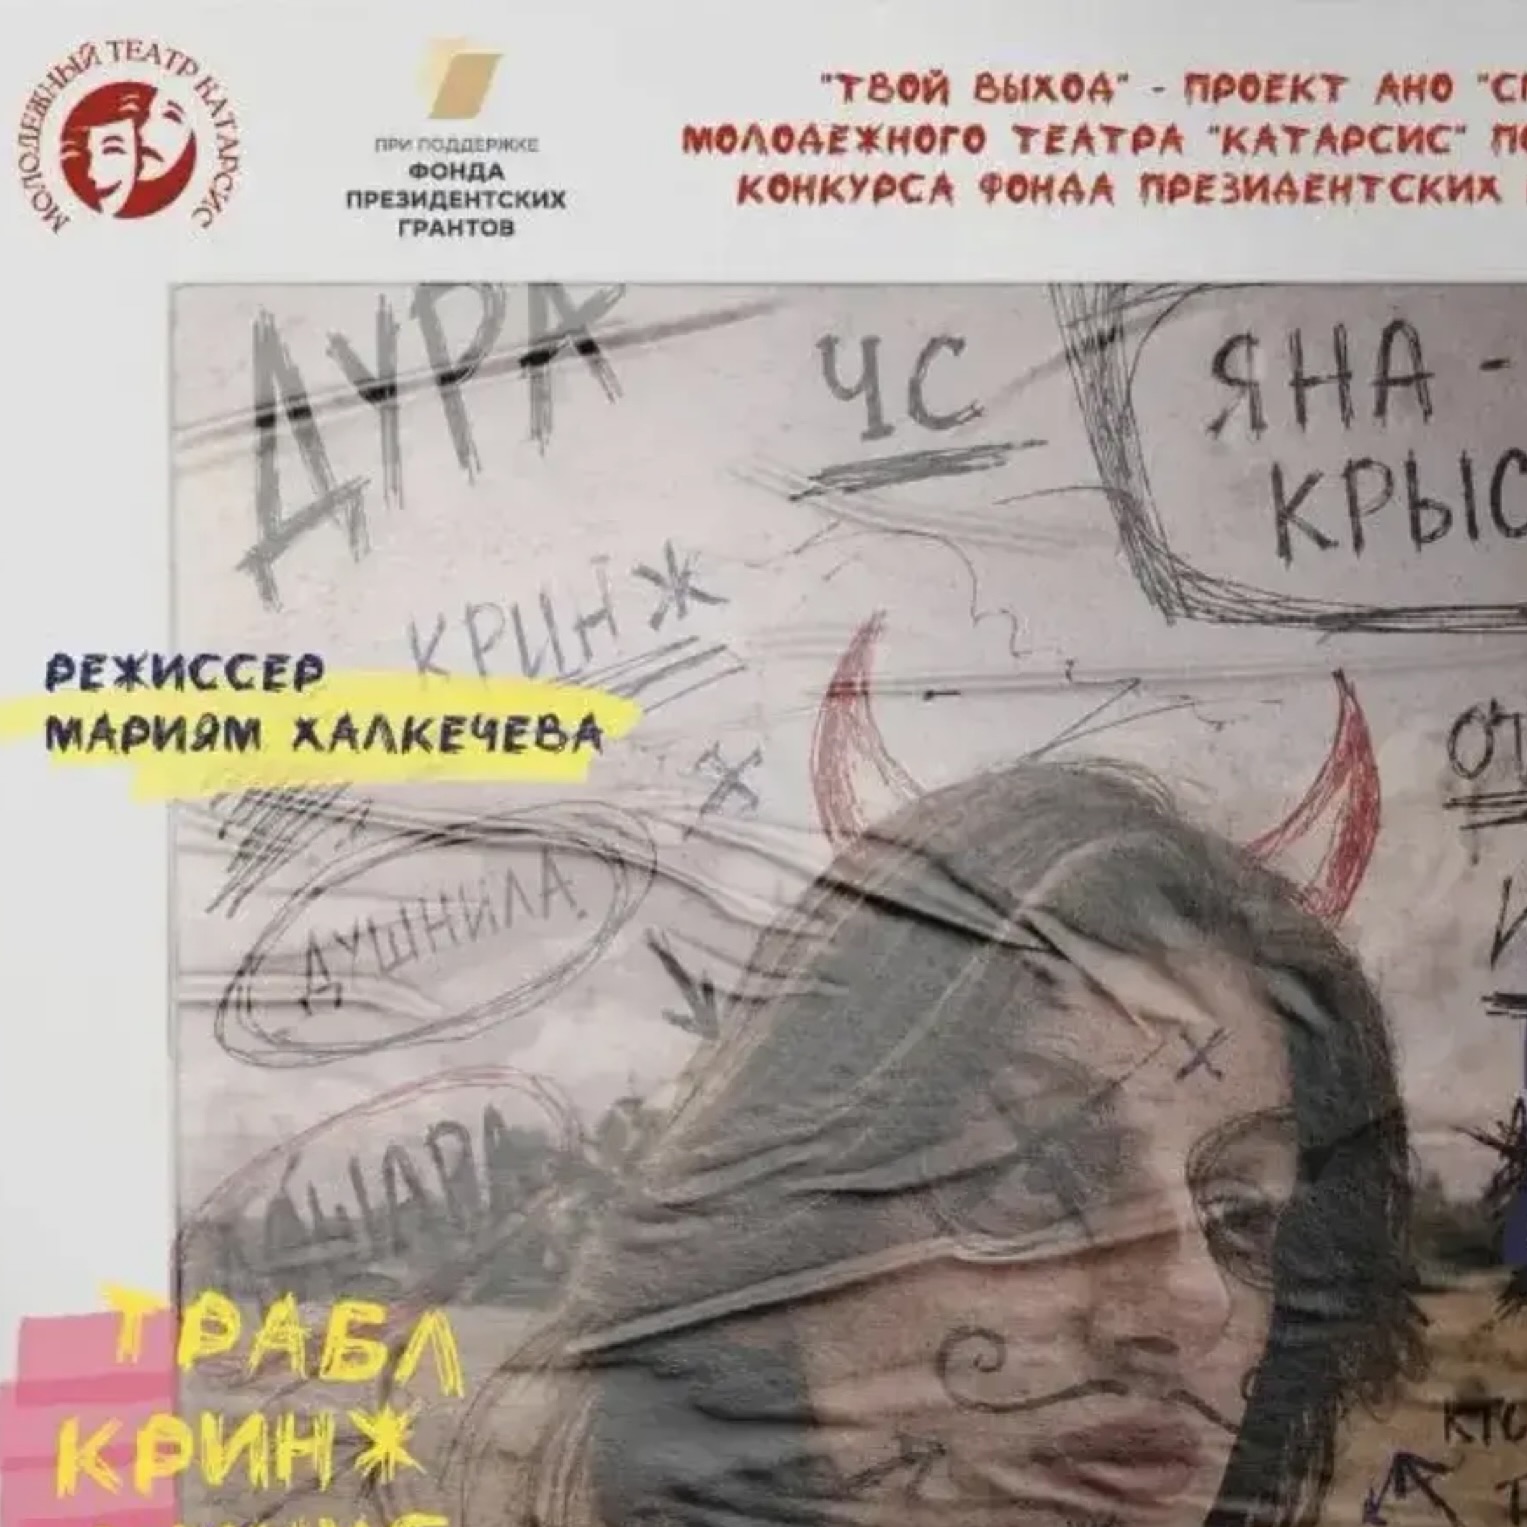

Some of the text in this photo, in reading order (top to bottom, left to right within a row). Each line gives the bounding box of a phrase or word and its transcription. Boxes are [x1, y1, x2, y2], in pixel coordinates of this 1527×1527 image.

[820, 70, 949, 105] "ТВОЙ
[974, 72, 1128, 105] ВЫХОД"
[1184, 72, 1349, 105] ПРОЕКТ
[1374, 72, 1453, 105] АНО
[105, 38, 199, 78] ТЕАТР
[191, 76, 243, 230] КАТАРСИС
[375, 137, 540, 154] ПРИ ПОДДЕРЖКЕ
[682, 123, 987, 156] МОЛОДЕЖНОГО
[1013, 123, 1184, 156] ТЕАТРА
[1208, 123, 1467, 156] "КАТАРСИС"
[409, 161, 504, 182] ФОНДА
[737, 172, 953, 206] КОНКУРСА
[979, 172, 1114, 206] ФОНДА
[1140, 172, 1503, 206] ПРЕЗИДЕНТСКИХ
[346, 189, 567, 211] ПРЕЗИДЕНТСКИХ
[398, 218, 516, 238] ГРАНТОВ
[815, 333, 985, 441] ЧС
[1207, 319, 1436, 440] ЯНА
[236, 282, 625, 613] ДУРА
[409, 541, 730, 685] КРИНЖ
[45, 652, 325, 692] РЕЖИССЕР
[45, 713, 603, 754] МАРИЯМ ХАЛКЕЧЕВА
[98, 1281, 465, 1399] ТРАБЛ
[55, 1400, 428, 1498] КРИНЖ
